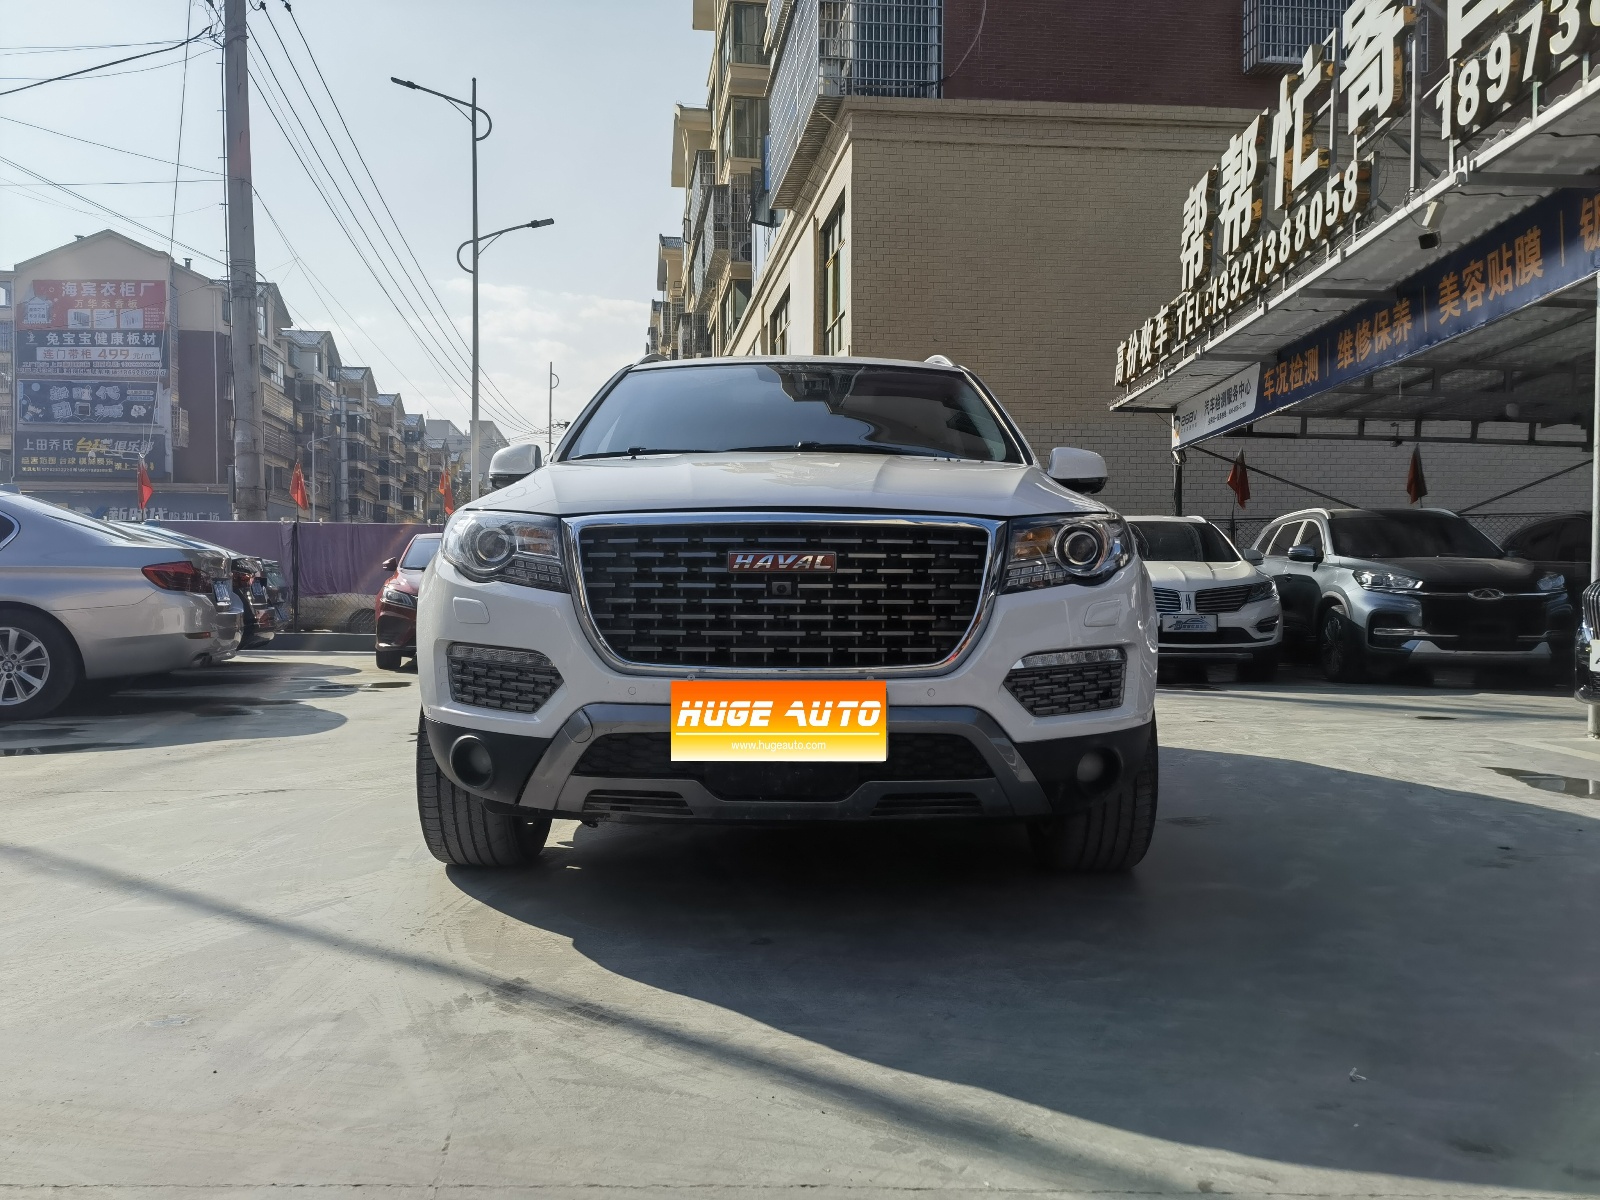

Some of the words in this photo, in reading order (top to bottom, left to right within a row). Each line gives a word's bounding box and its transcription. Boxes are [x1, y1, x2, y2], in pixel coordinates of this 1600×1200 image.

[1436, 0, 1600, 140] 18973
[1180, 0, 1520, 291] 帮帮忙寄
[61, 281, 156, 297] 海宾衣柜厂
[1262, 345, 1320, 401] 车况检测
[1337, 297, 1412, 369] 维修保养
[1438, 225, 1544, 326] 美容贴膜
[43, 349, 92, 360] 连门带柜
[97, 349, 129, 360] 499
[46, 332, 157, 346] 兔宝宝健康板材
[1114, 305, 1169, 386] 高价收车
[1204, 378, 1252, 416] 汽车检测服务中心
[733, 554, 831, 569] HAVAL
